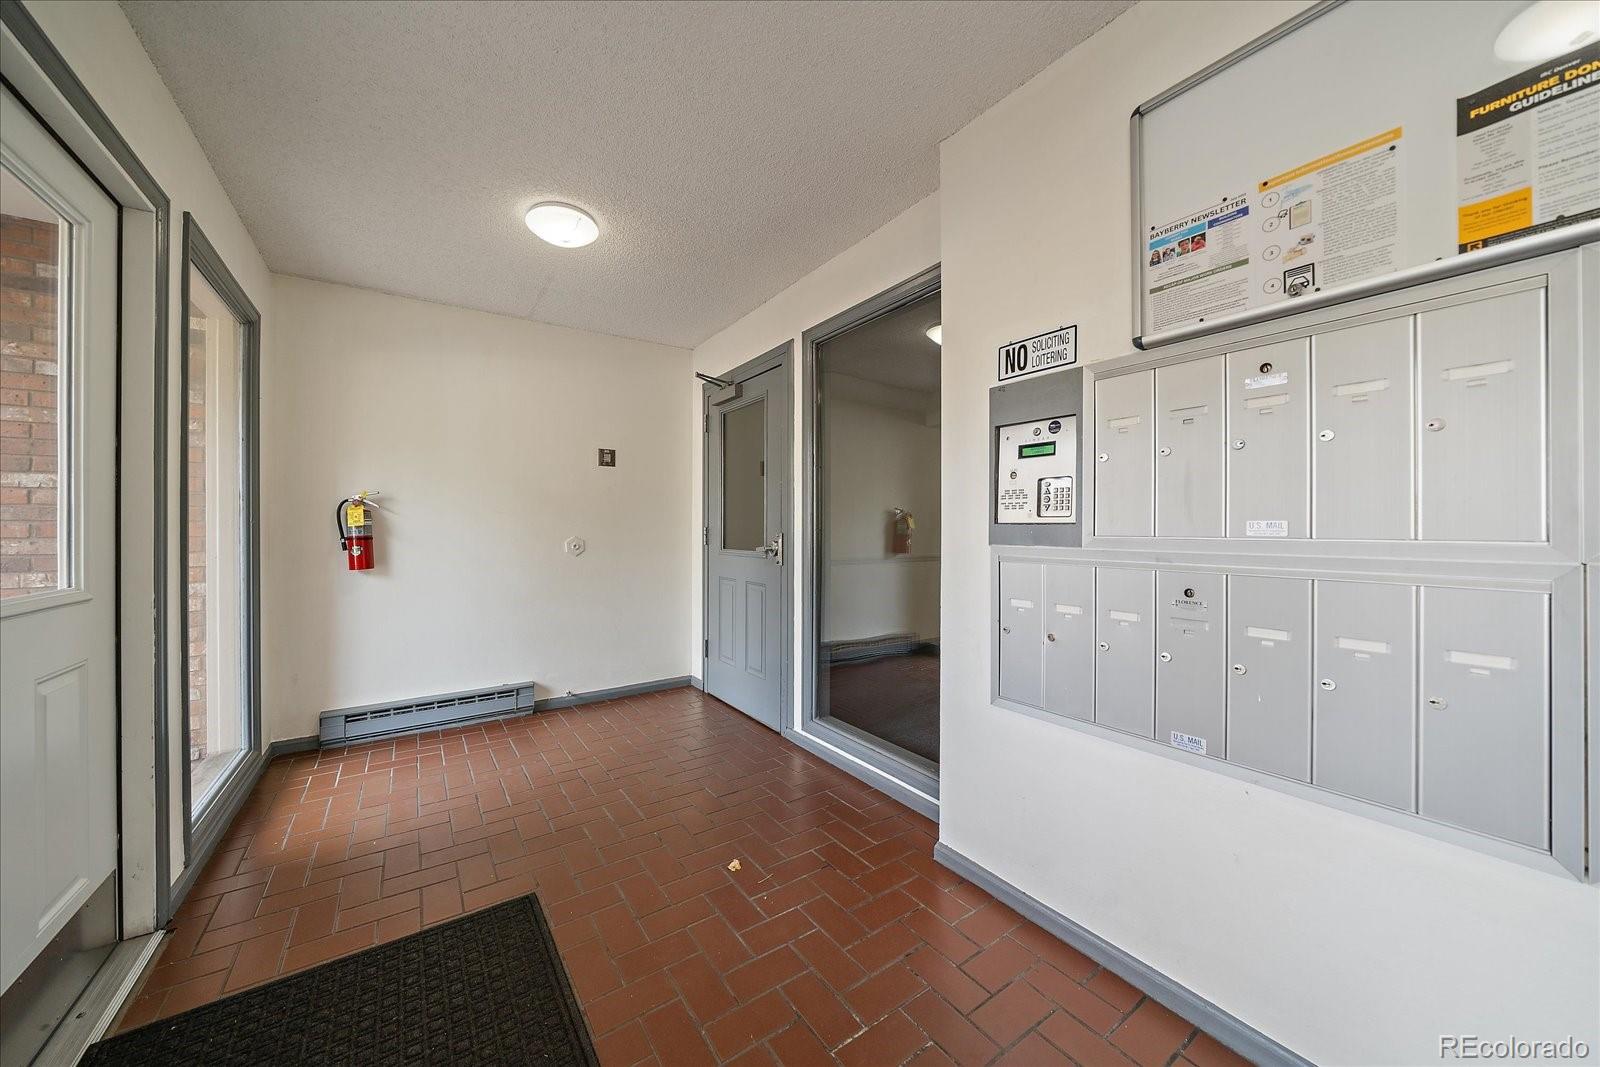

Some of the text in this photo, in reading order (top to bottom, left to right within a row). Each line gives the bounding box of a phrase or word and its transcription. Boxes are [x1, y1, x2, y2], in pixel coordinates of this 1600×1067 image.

[1470, 75, 1560, 118] FURNITURE
[1150, 220, 1190, 240] BAYBERRY
[1191, 198, 1247, 224] NEWSLETTER
[1032, 332, 1070, 353] SOLICITING
[1005, 344, 1028, 375] NO
[1031, 348, 1068, 368] LOITERING
[1265, 521, 1285, 529] MAIL
[1187, 736, 1203, 747] MAIL
